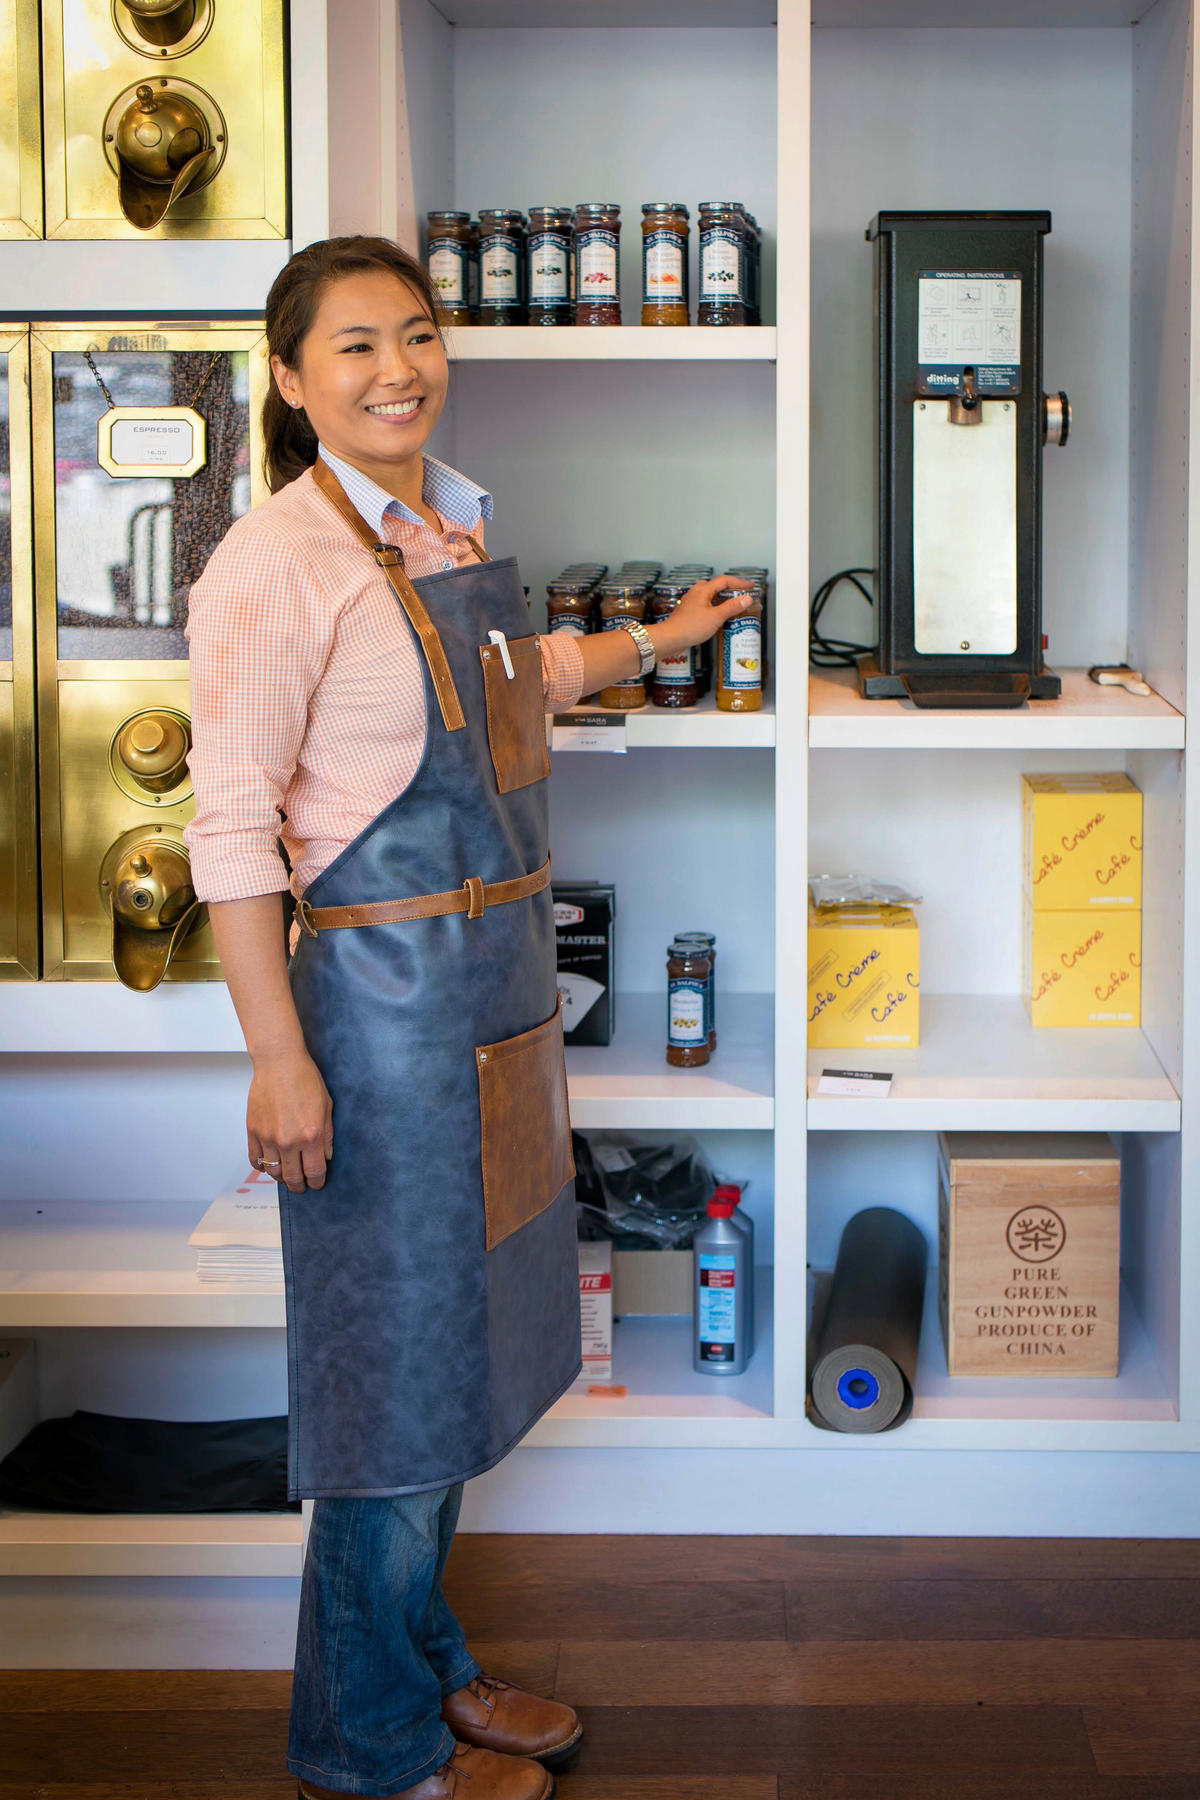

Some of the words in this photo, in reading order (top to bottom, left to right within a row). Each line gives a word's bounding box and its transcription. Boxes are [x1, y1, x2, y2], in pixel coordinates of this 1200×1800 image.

[926, 373, 960, 385] ditting
[1012, 1267, 1061, 1281] PURE
[1004, 1286, 1069, 1300] GREEN
[975, 1305, 1098, 1319] GUNPOWDER
[978, 1323, 1067, 1337] PRODUCE
[1071, 1323, 1096, 1337] OF
[1007, 1342, 1066, 1356] CHINA
